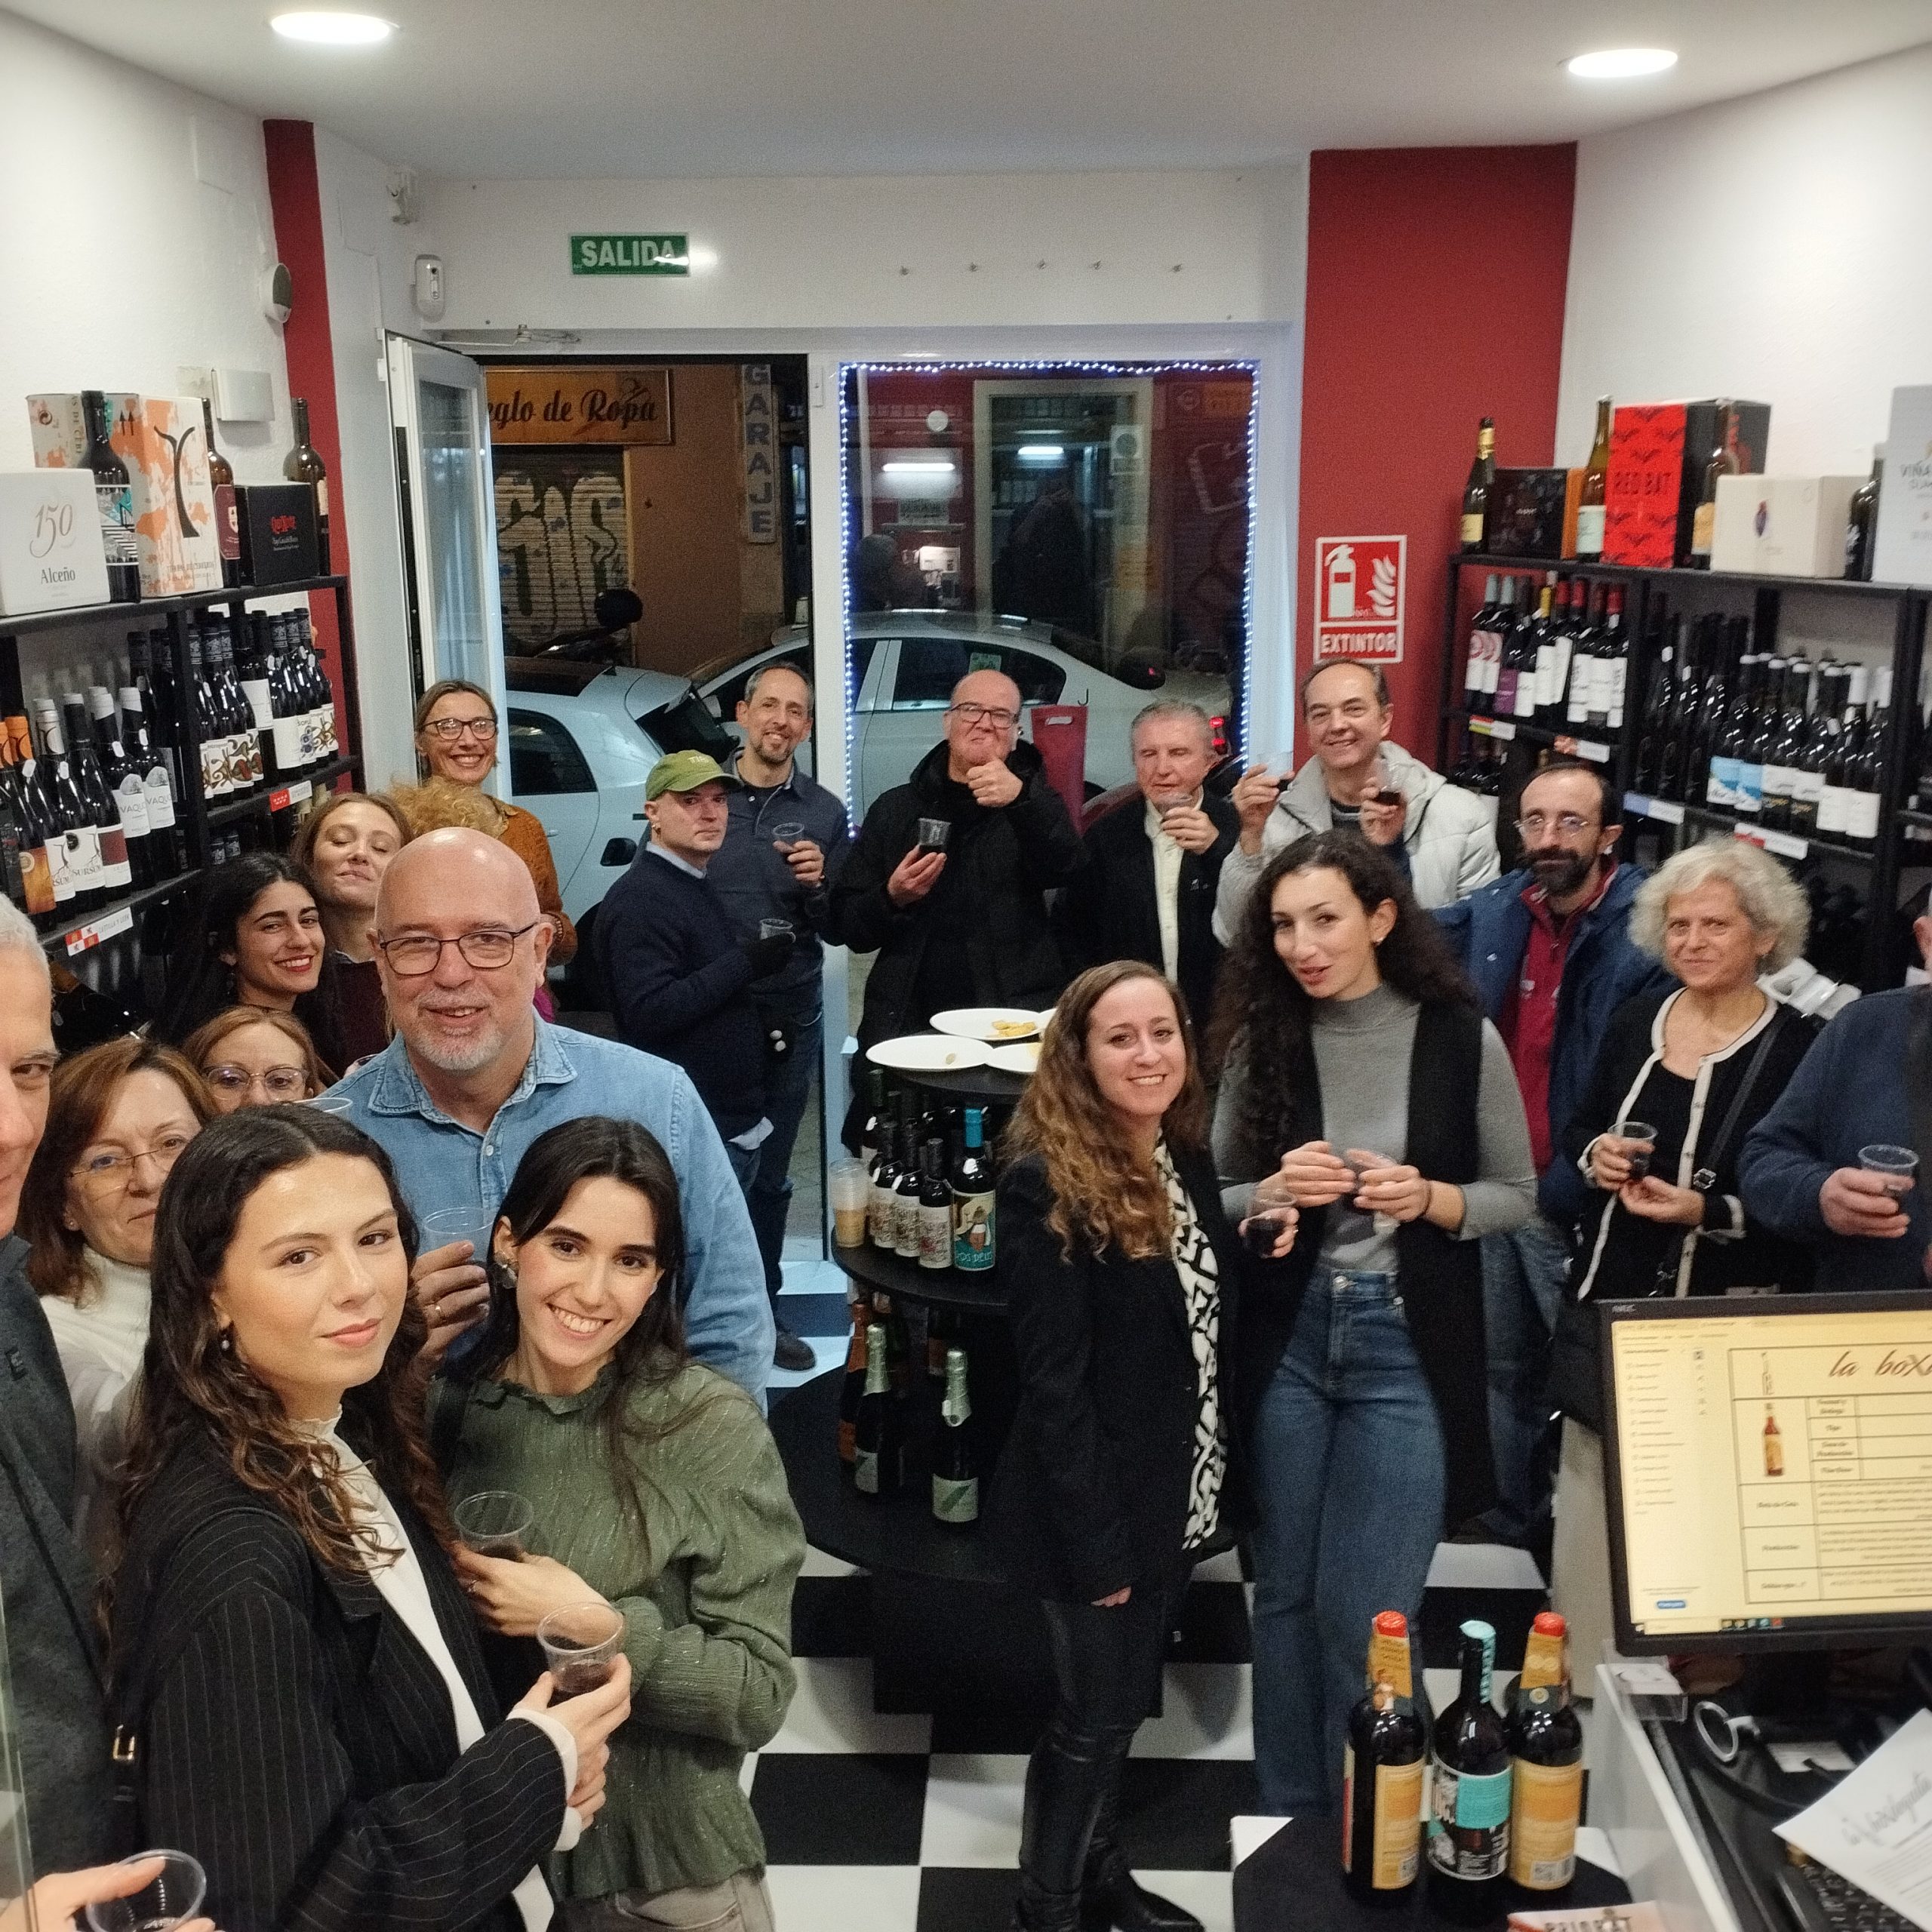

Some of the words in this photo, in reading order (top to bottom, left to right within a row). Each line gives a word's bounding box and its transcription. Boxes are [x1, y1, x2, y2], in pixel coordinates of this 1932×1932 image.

[580, 240, 678, 267] SALIDA
[543, 389, 574, 422] de
[580, 389, 659, 430] Ropa
[744, 365, 773, 533] GARAJE
[30, 503, 73, 558] 150
[41, 567, 76, 584] Alceño
[1321, 632, 1396, 653] EXTINTOR
[1828, 1350, 1860, 1377] la
